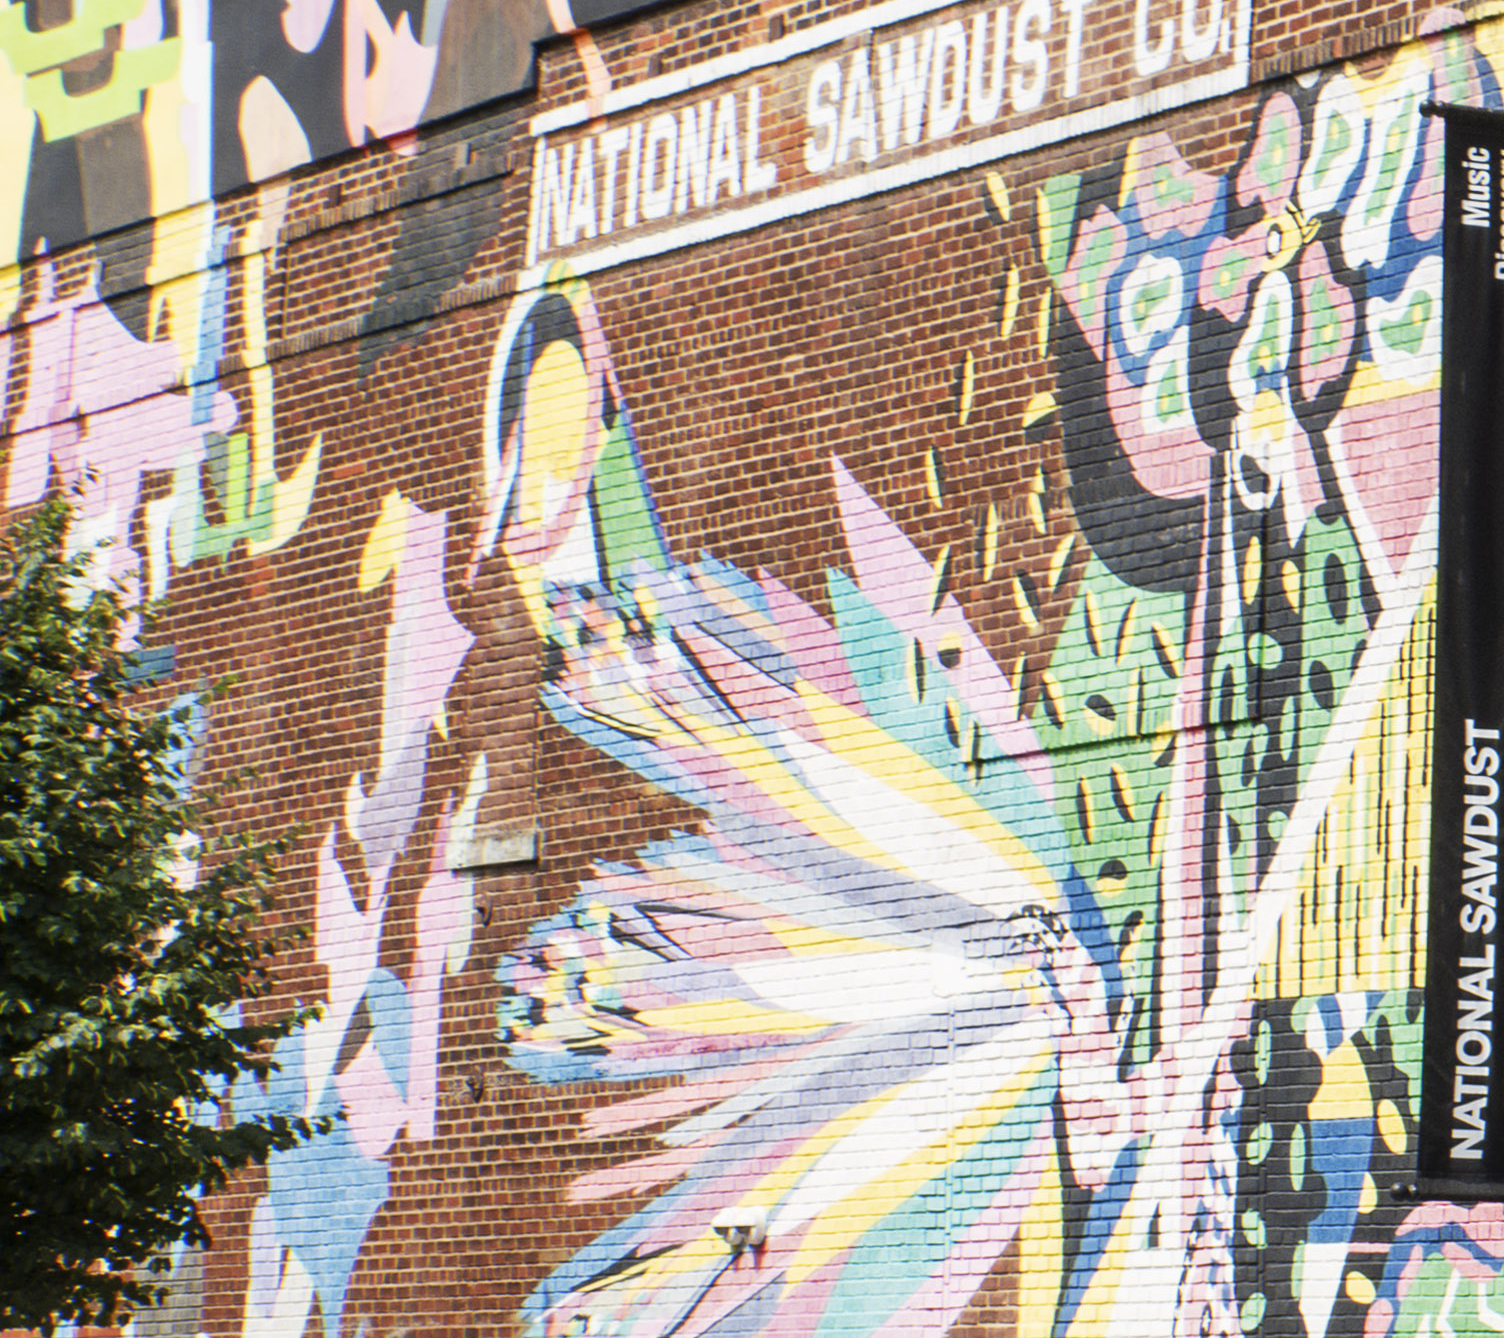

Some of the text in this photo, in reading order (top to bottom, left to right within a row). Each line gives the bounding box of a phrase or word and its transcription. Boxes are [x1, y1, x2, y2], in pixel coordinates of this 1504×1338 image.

[543, 84, 777, 248] NATIONAL
[1461, 147, 1491, 228] Music
[1449, 719, 1500, 1159] NATIONAL SAWDUST
